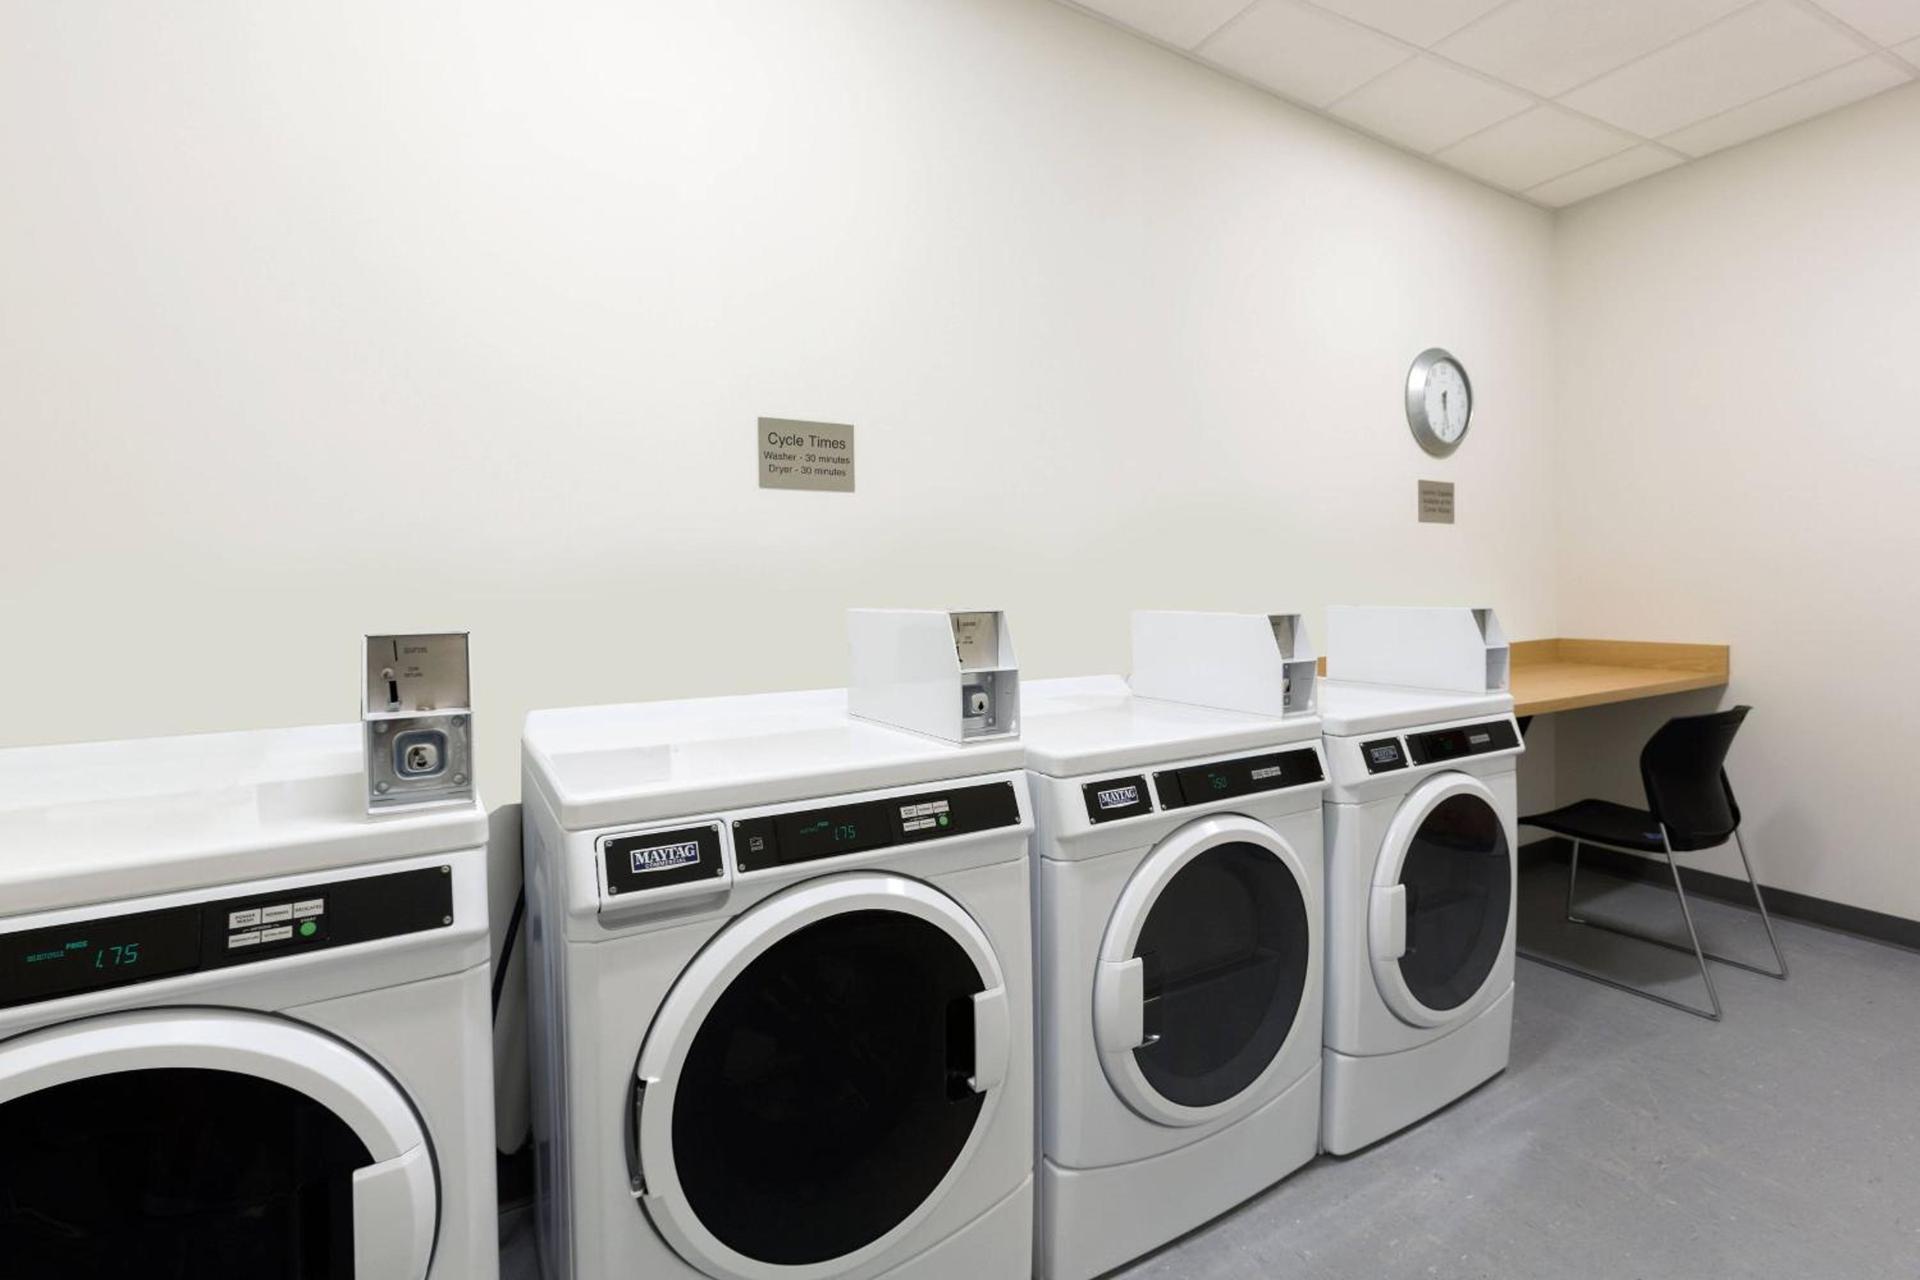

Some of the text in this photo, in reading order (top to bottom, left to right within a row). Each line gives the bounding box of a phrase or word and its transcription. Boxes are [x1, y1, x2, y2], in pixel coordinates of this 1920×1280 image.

[768, 432, 846, 450] Cycle Times
[763, 451, 796, 461] Washer
[804, 454, 816, 463] 30
[818, 456, 850, 464] minutes
[768, 464, 792, 474] Dryer
[800, 466, 812, 474] 30
[814, 467, 846, 476] minutes
[635, 845, 696, 865] MAYTAG
